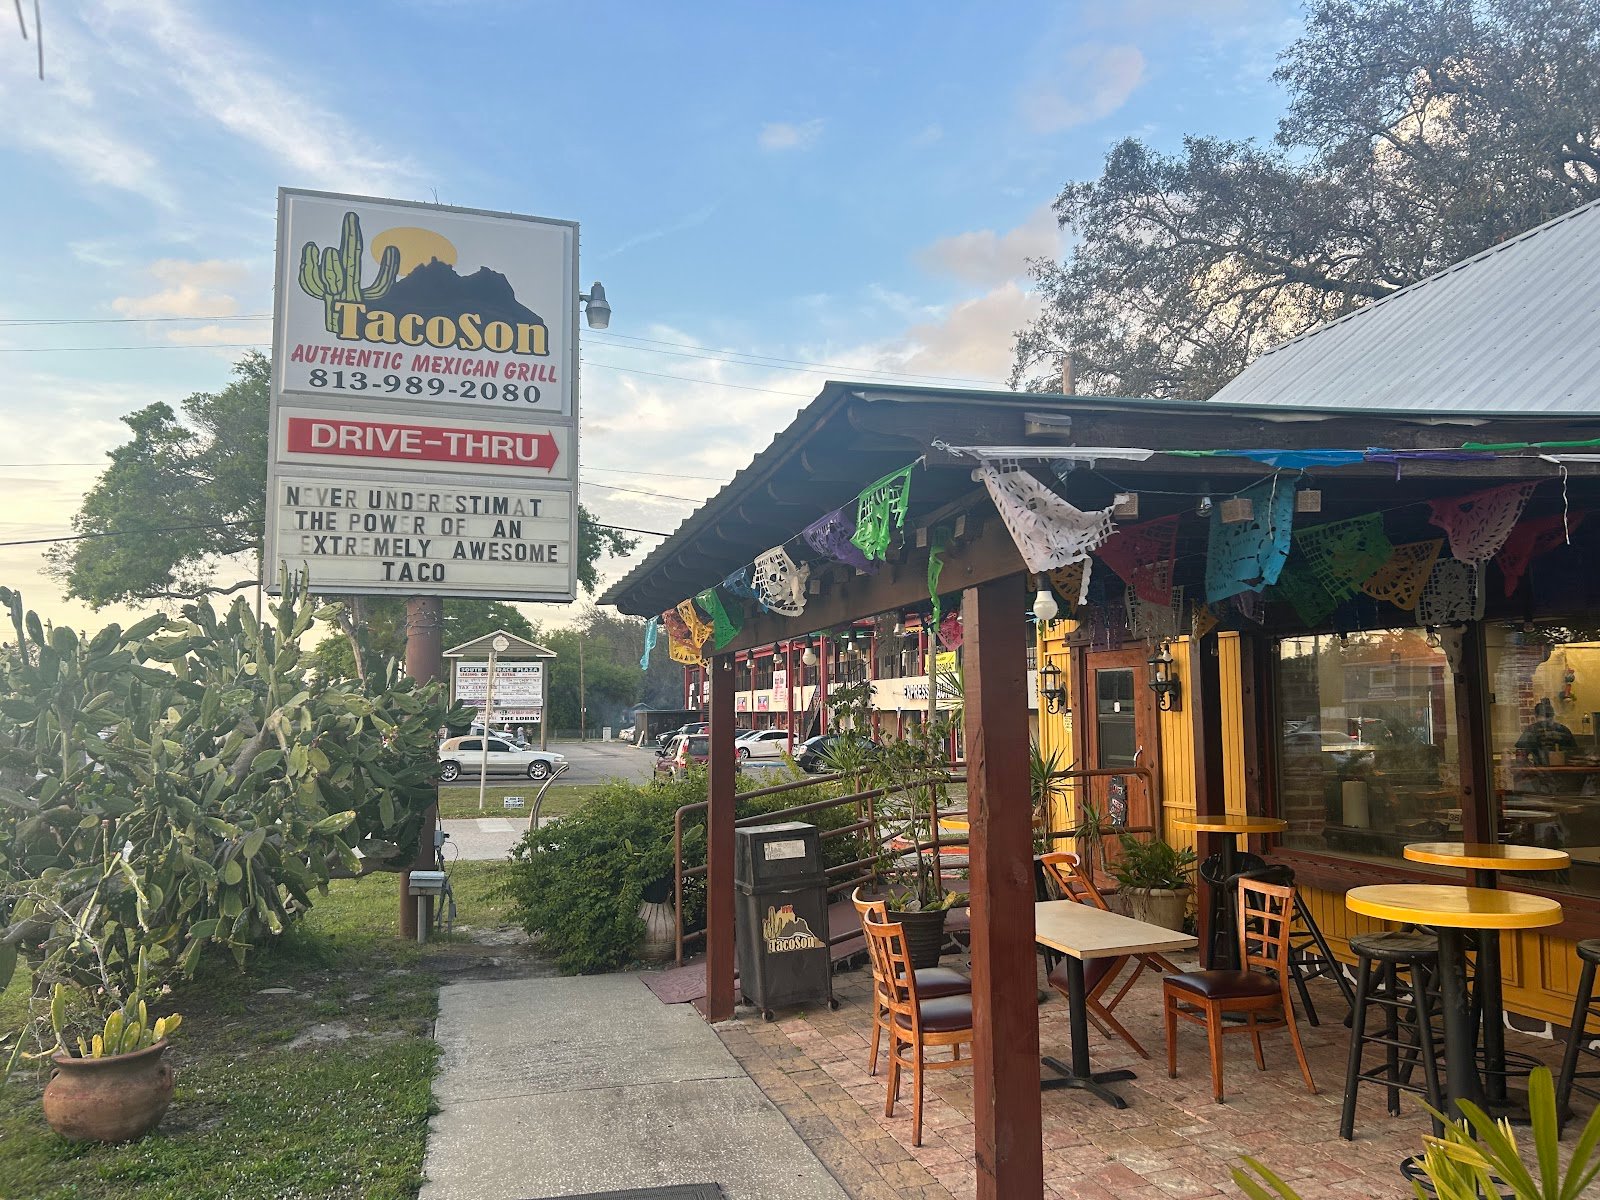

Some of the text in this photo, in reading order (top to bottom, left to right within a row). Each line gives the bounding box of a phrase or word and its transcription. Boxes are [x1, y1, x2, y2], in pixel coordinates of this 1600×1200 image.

[334, 300, 550, 356] TacoSon
[291, 344, 558, 383] AUTHENTIC MEXICAN GRILL
[309, 368, 541, 403] 813-989-2080
[311, 423, 539, 462] DRIVE-THRU
[286, 486, 542, 517] NEVER UNDERESTIMAT
[295, 510, 522, 539] THE POWER OF AN
[301, 535, 558, 563] EXTREMELY AWESOME
[382, 561, 445, 582] TACO
[903, 684, 929, 699] EXPRESS
[769, 936, 815, 952] TacoSon
